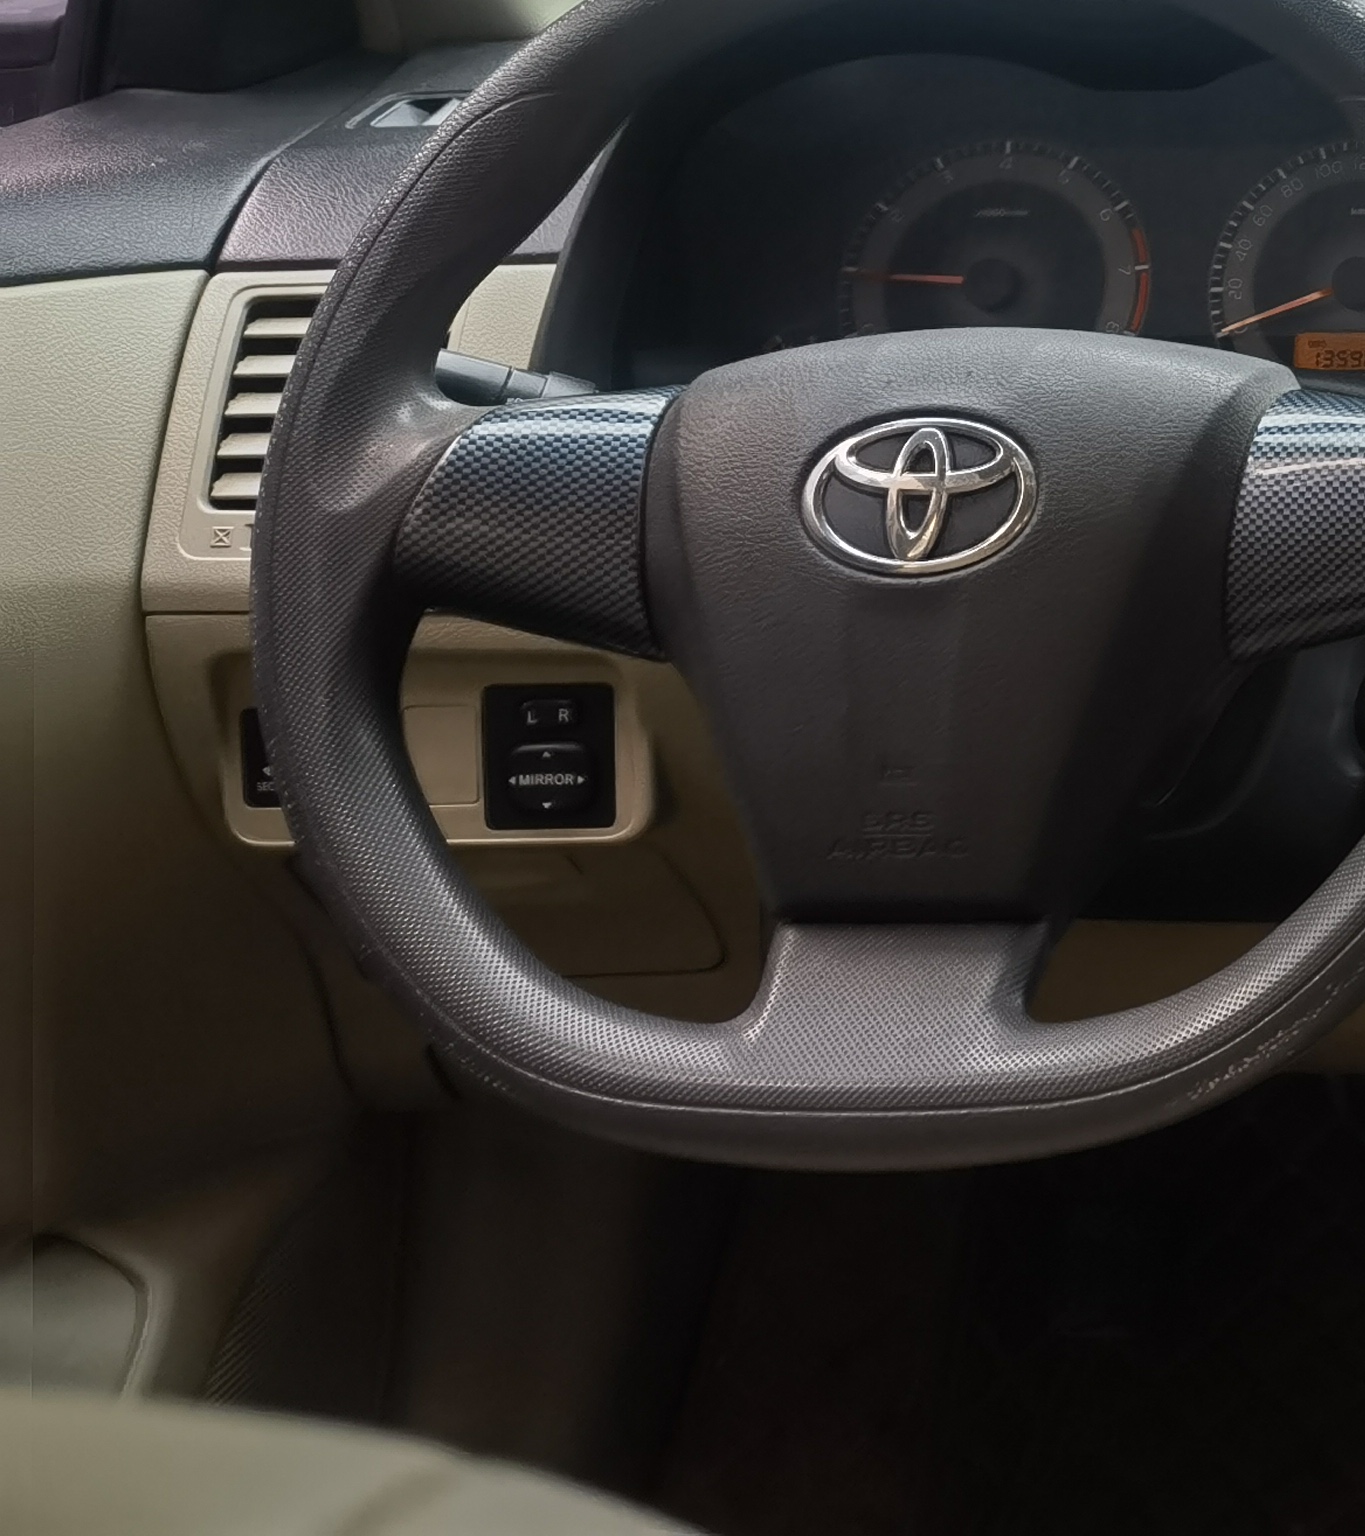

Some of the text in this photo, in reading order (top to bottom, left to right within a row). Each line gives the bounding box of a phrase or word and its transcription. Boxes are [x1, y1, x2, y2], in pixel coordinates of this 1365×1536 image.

[1280, 177, 1304, 199] 80
[1252, 204, 1274, 227] 60
[1235, 238, 1254, 262] 40
[1228, 277, 1243, 300] 20
[526, 710, 538, 724] L
[558, 708, 569, 723] R
[519, 773, 574, 785] MIRROR
